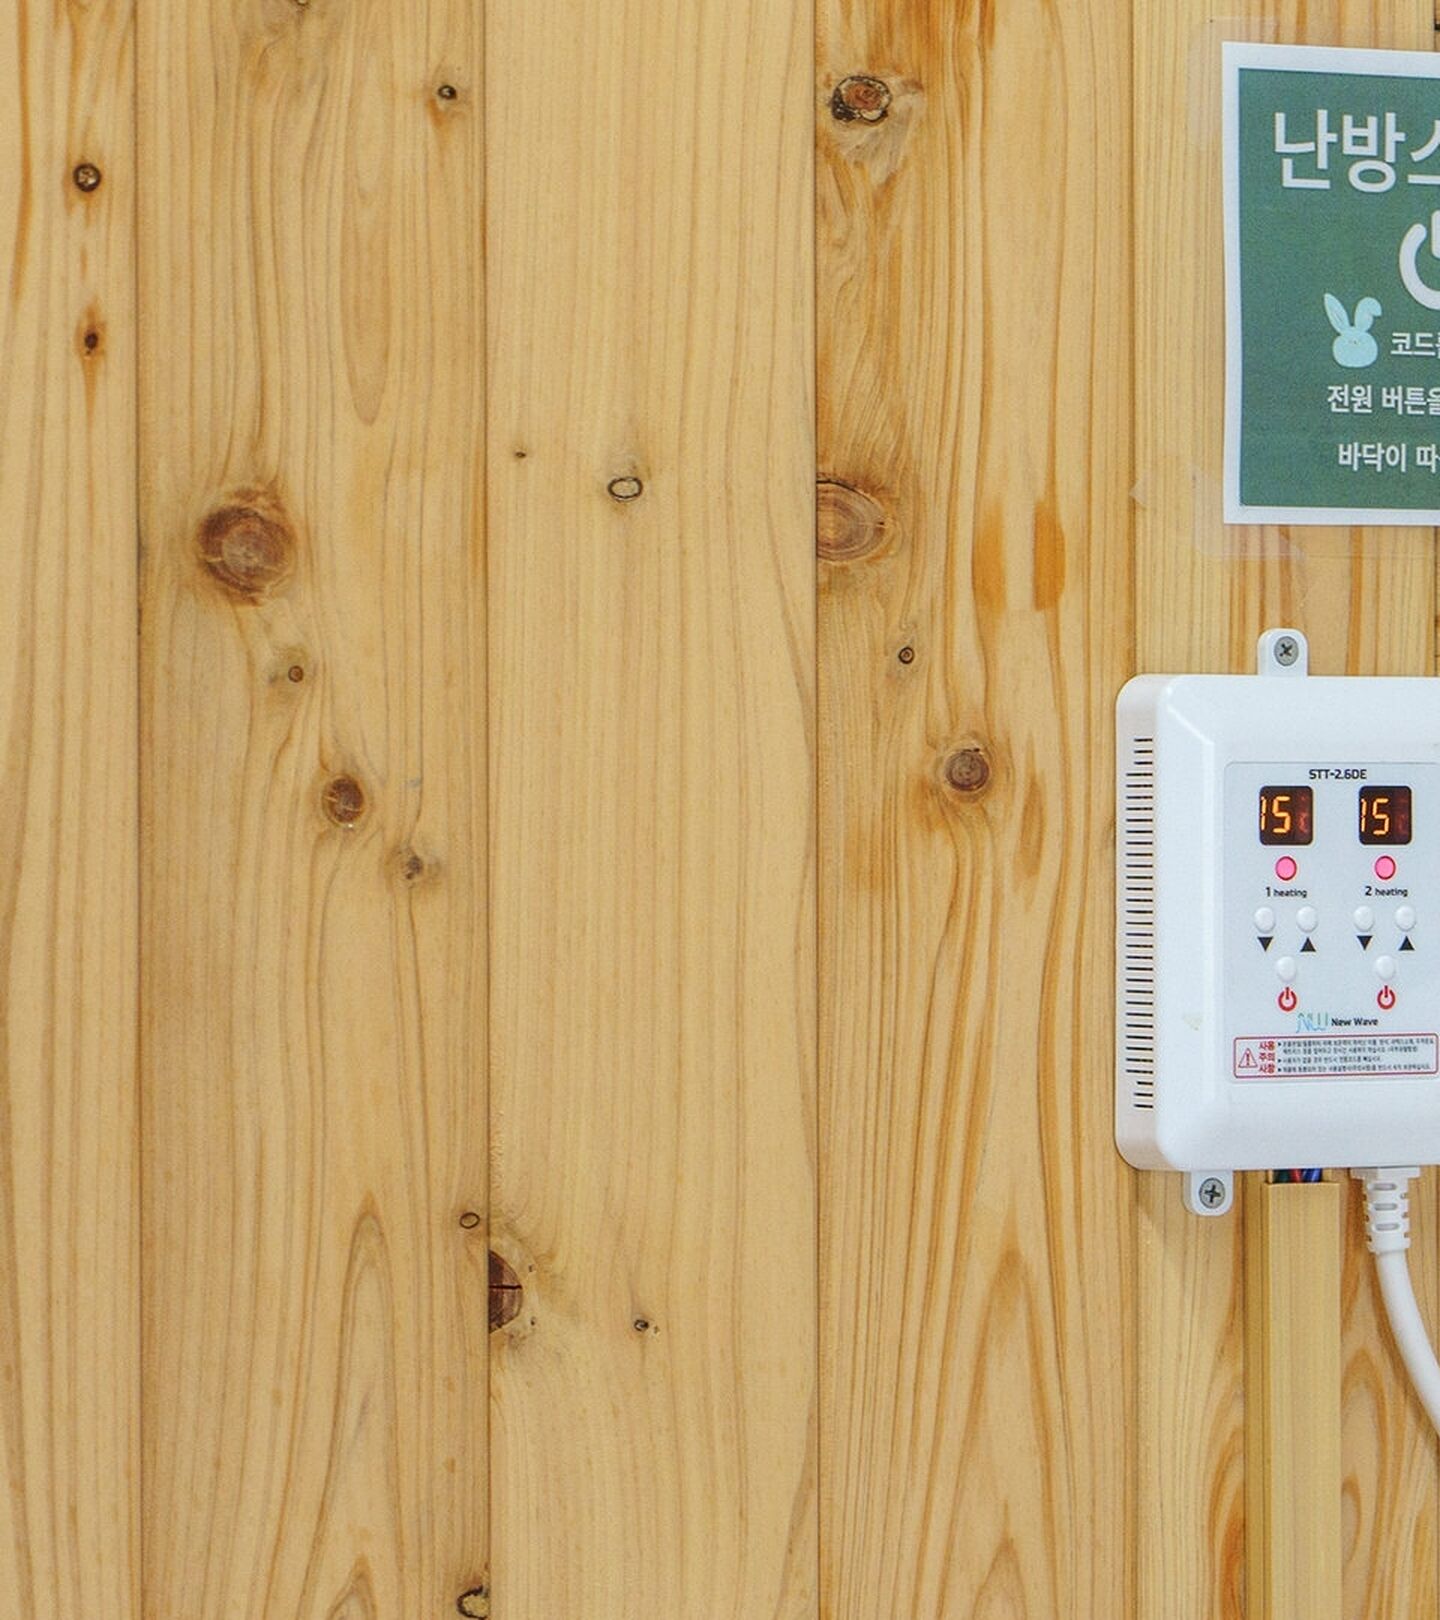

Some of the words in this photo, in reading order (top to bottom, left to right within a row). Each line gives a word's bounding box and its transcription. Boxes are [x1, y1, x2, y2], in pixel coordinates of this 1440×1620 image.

[1327, 384, 1373, 414] 전원
[1337, 442, 1407, 472] 바닥이
[1308, 769, 1368, 780] STT-2.6DE
[1265, 887, 1271, 897] 1
[1273, 888, 1308, 899] heating
[1364, 886, 1372, 896] 2
[1375, 887, 1409, 898] heating
[1331, 1018, 1351, 1027] New
[1353, 1017, 1379, 1027] Wave
[1259, 1041, 1275, 1051] 사용
[1259, 1052, 1275, 1062] 주의
[1259, 1063, 1275, 1074] 사항
